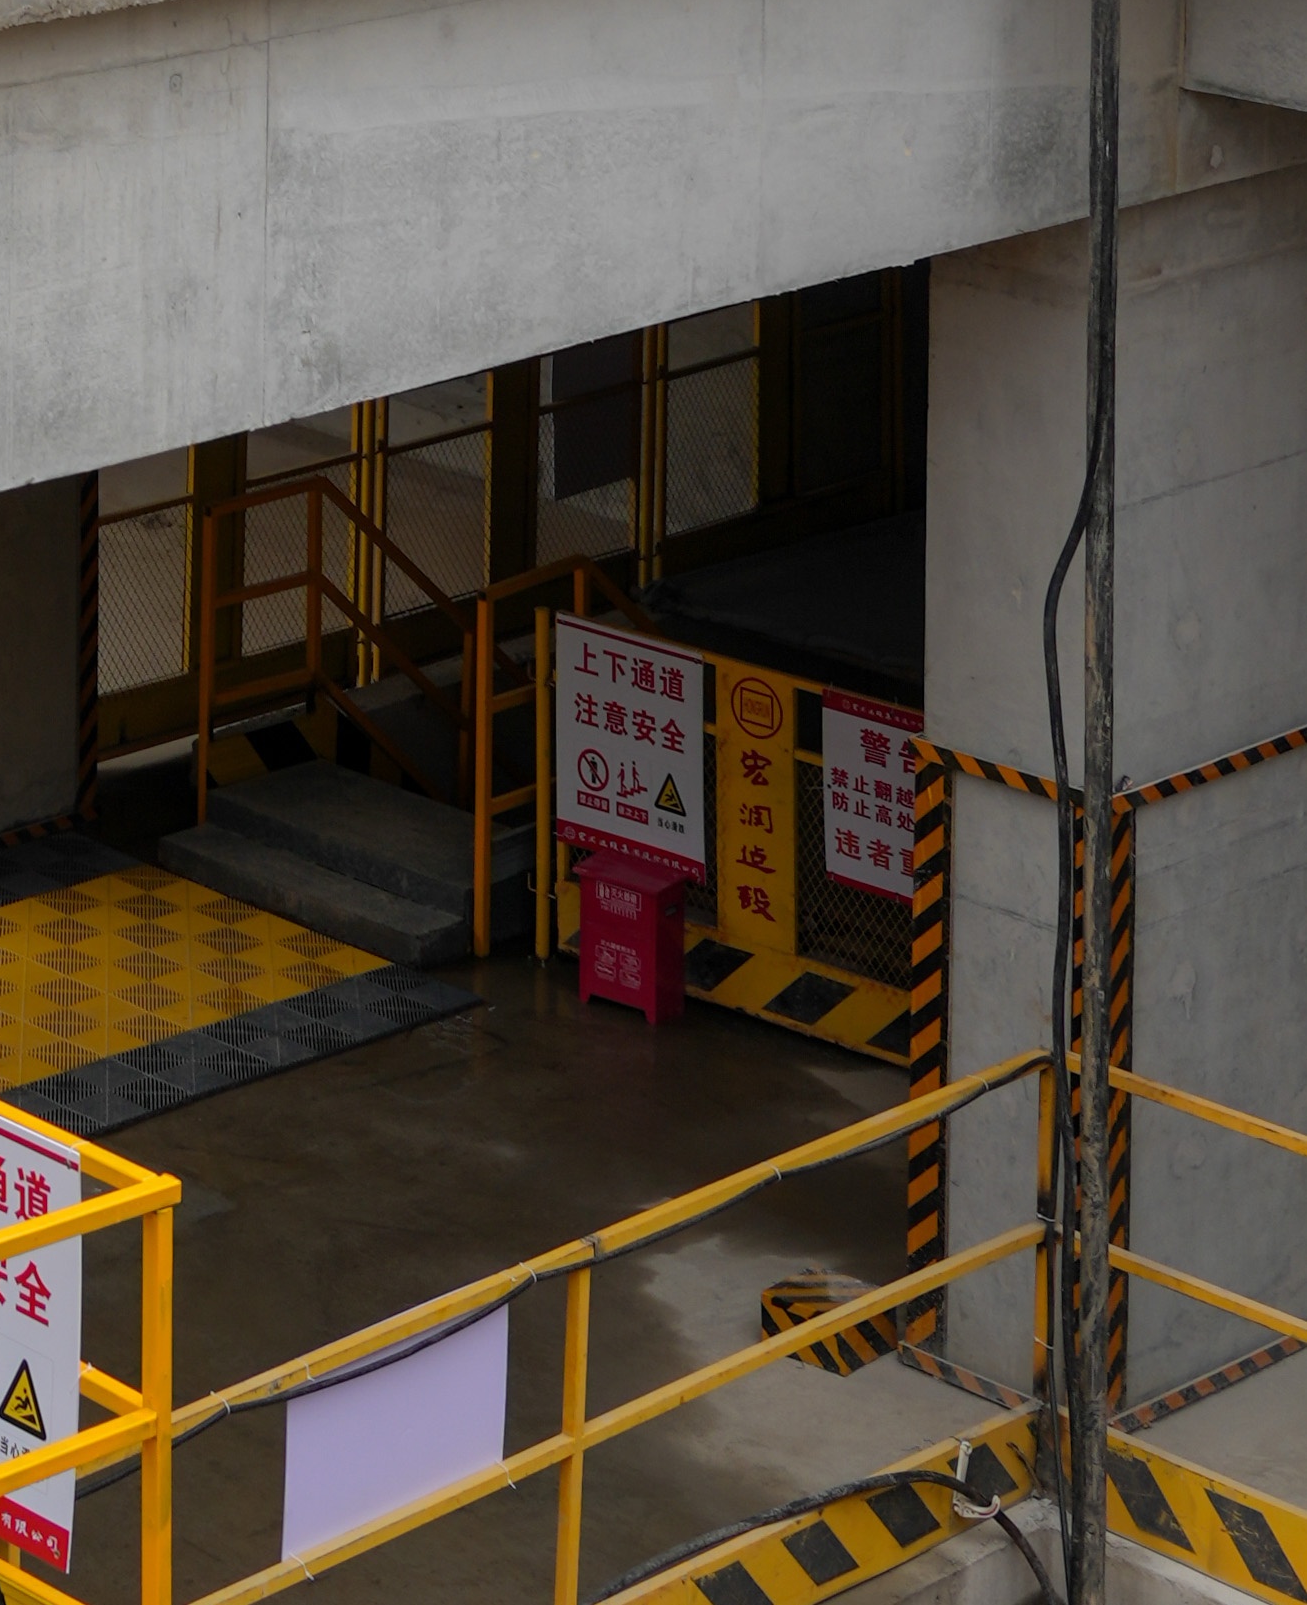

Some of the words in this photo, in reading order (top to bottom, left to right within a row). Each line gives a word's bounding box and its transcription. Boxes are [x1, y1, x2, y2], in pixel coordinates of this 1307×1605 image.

[574, 642, 685, 703] 上下通道
[574, 692, 686, 754] 注意安全
[736, 749, 777, 923] 宏润建设
